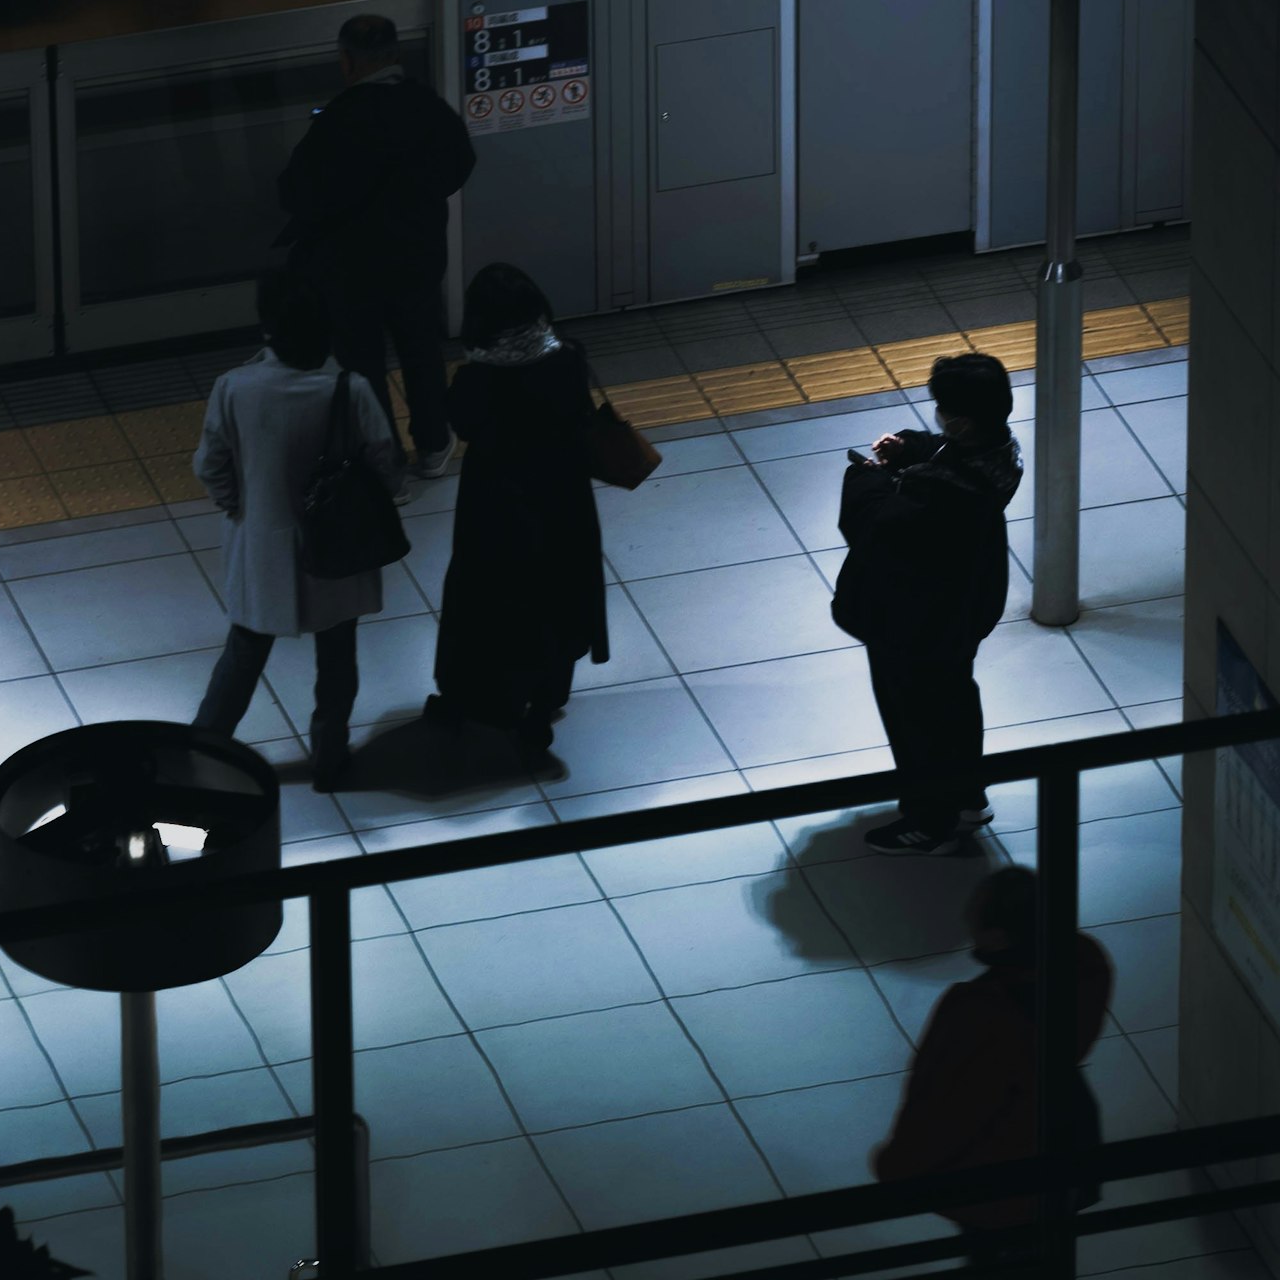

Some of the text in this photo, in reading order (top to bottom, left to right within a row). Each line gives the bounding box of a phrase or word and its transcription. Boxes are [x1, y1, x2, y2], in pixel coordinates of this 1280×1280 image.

[473, 29, 491, 54] 8
[512, 30, 523, 48] 1
[474, 67, 492, 92] 8
[514, 67, 523, 86] 1
